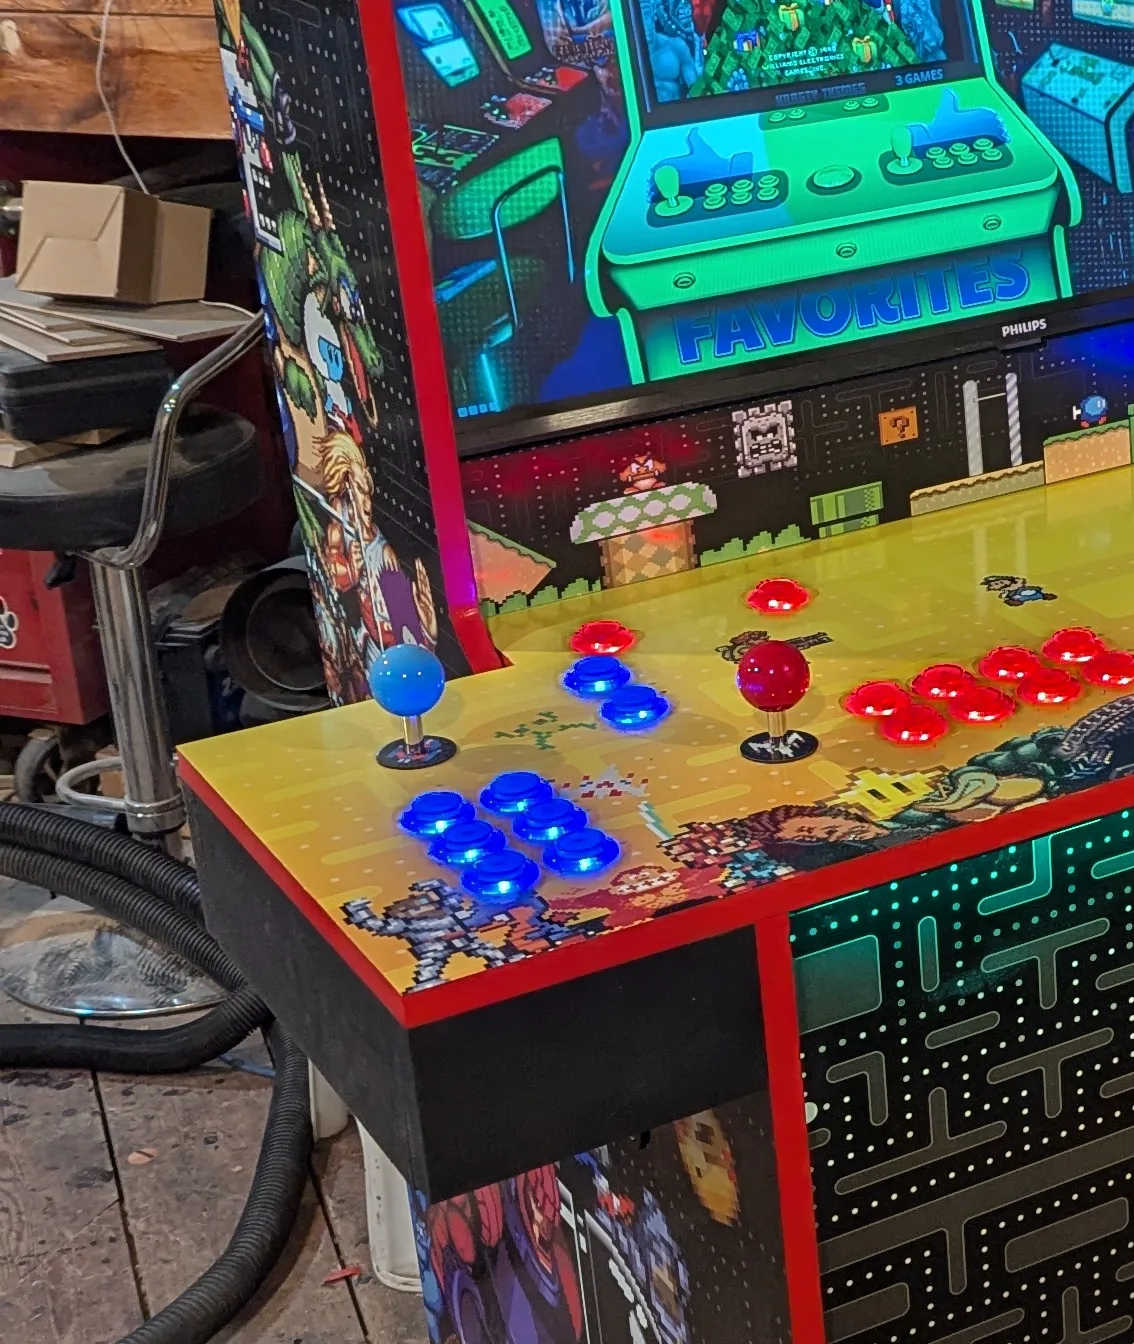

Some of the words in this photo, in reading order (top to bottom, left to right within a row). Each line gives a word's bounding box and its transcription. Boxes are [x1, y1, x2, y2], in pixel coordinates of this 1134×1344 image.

[895, 73, 904, 86] 3
[905, 68, 944, 84] GAMES
[671, 253, 1033, 365] FAVORITES
[1001, 318, 1047, 338] PHILIPS
